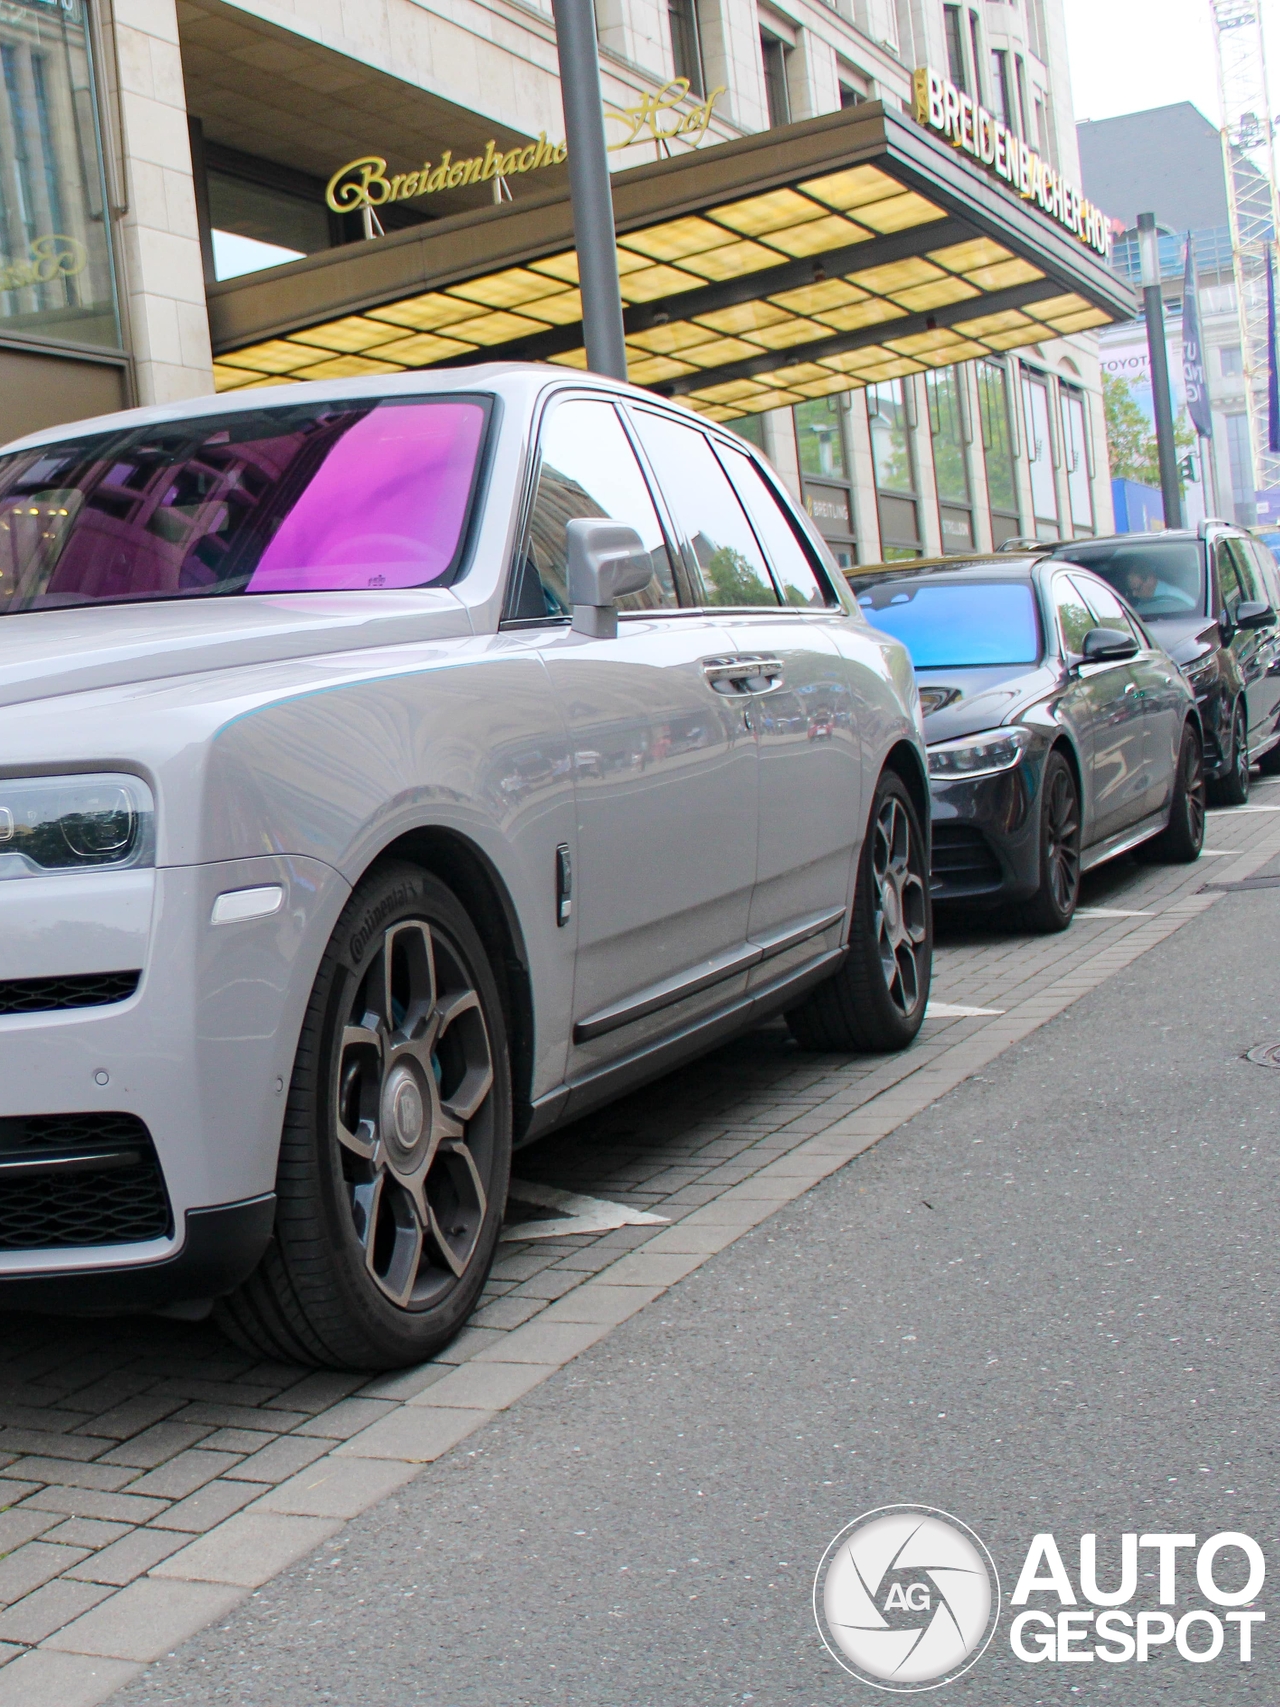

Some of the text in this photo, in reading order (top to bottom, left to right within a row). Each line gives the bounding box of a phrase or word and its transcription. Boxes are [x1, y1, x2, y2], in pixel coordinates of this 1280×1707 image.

[326, 76, 726, 213] Breidenbache Hof
[920, 67, 1112, 258] BREIDENBACHER HOF
[1099, 355, 1150, 371] TOYOT
[813, 501, 849, 521] BREITLING
